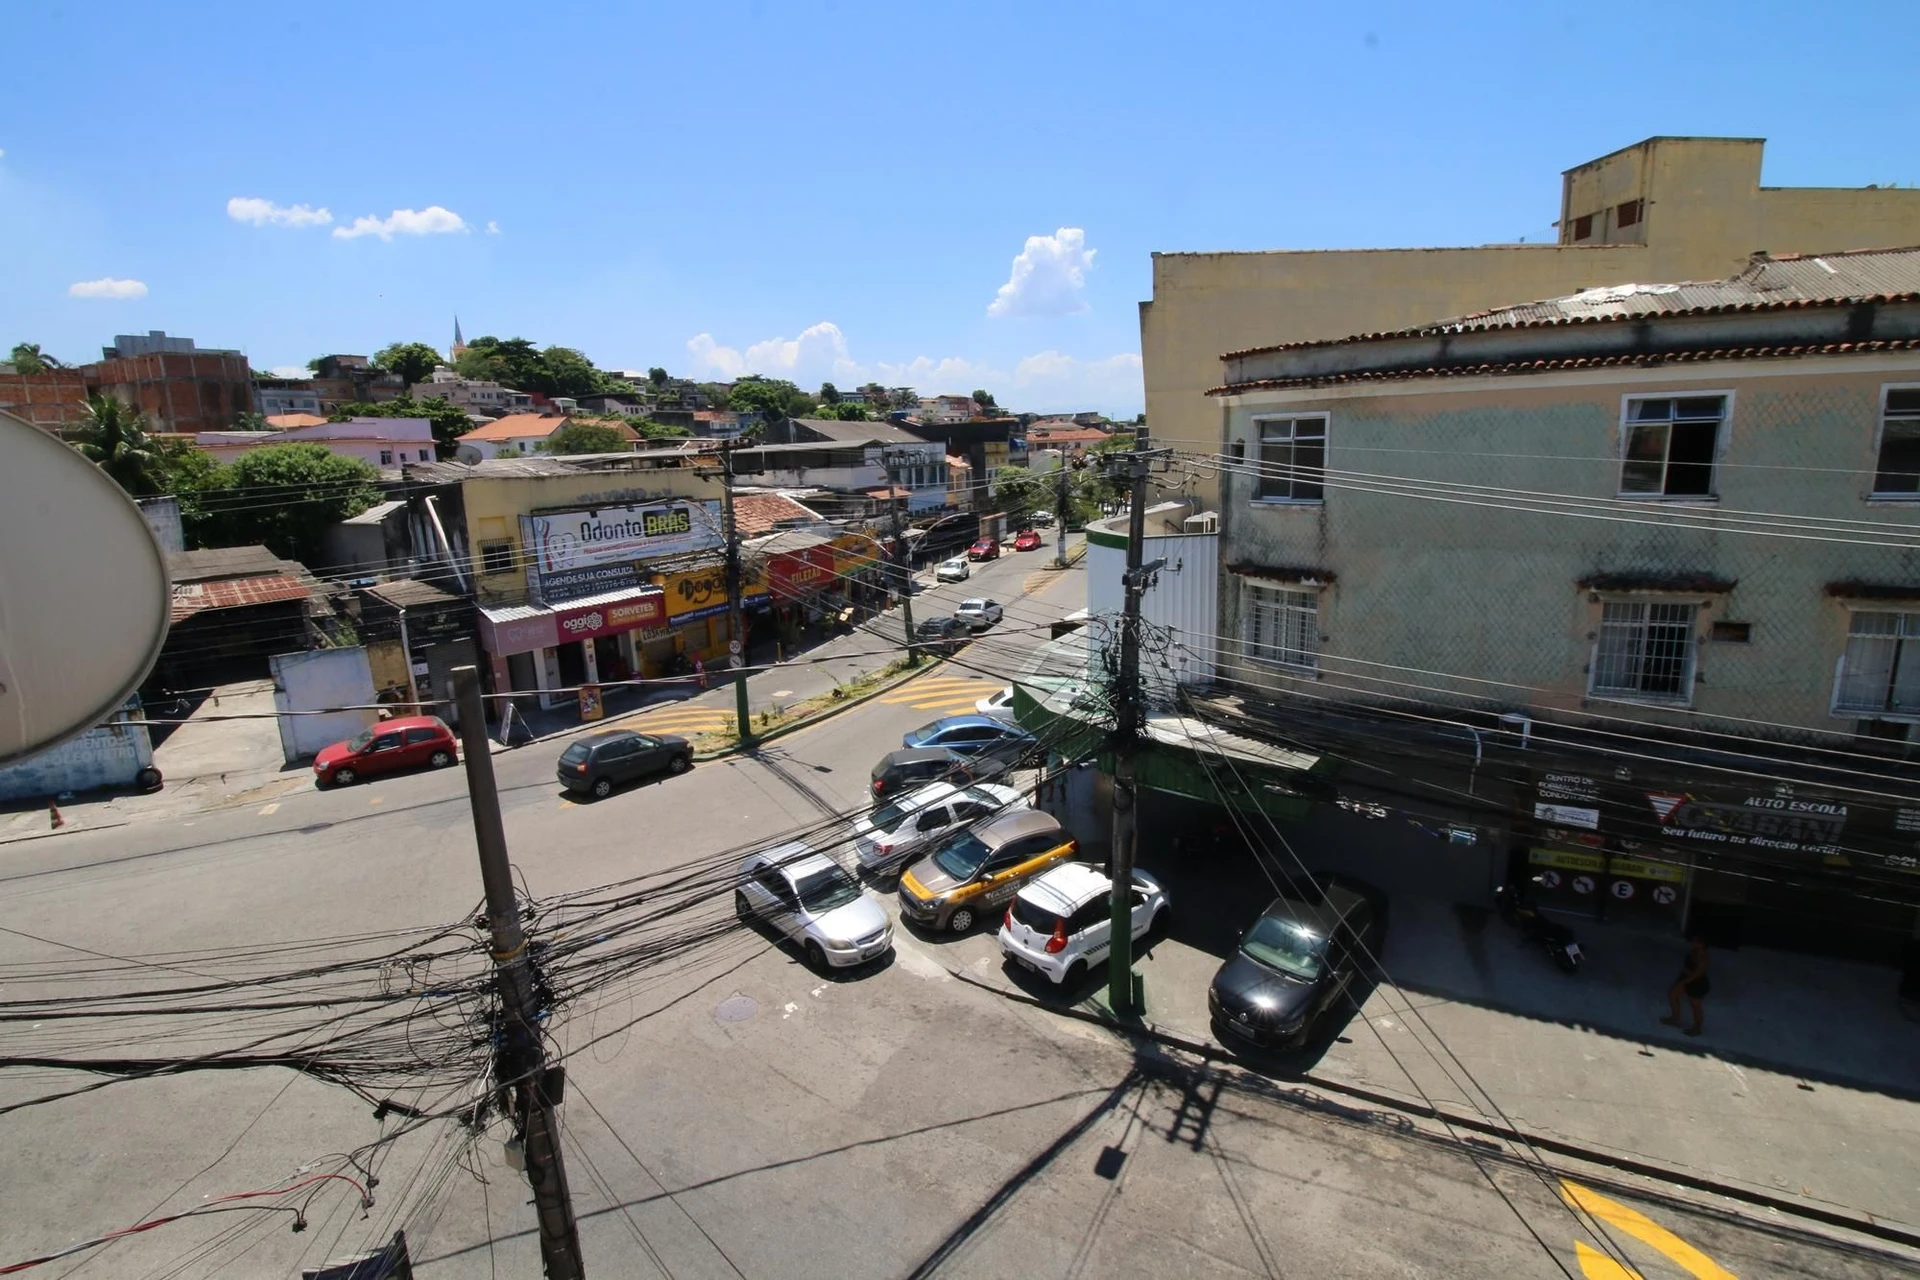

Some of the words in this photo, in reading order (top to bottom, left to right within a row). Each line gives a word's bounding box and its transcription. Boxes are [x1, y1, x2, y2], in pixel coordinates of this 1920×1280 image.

[580, 519, 642, 543] Odonto
[544, 575, 577, 588] AGENDE
[612, 603, 654, 618] SORVETES
[563, 614, 587, 630] oggi
[1545, 774, 1581, 784] CENTRO
[1581, 777, 1595, 785] DE
[1744, 796, 1785, 809] AUTO
[1788, 799, 1848, 816] ESCOLA
[1661, 826, 1685, 837] Seu
[1688, 828, 1727, 841] futuro
[1729, 836, 1746, 845] na
[1617, 884, 1628, 896] E
